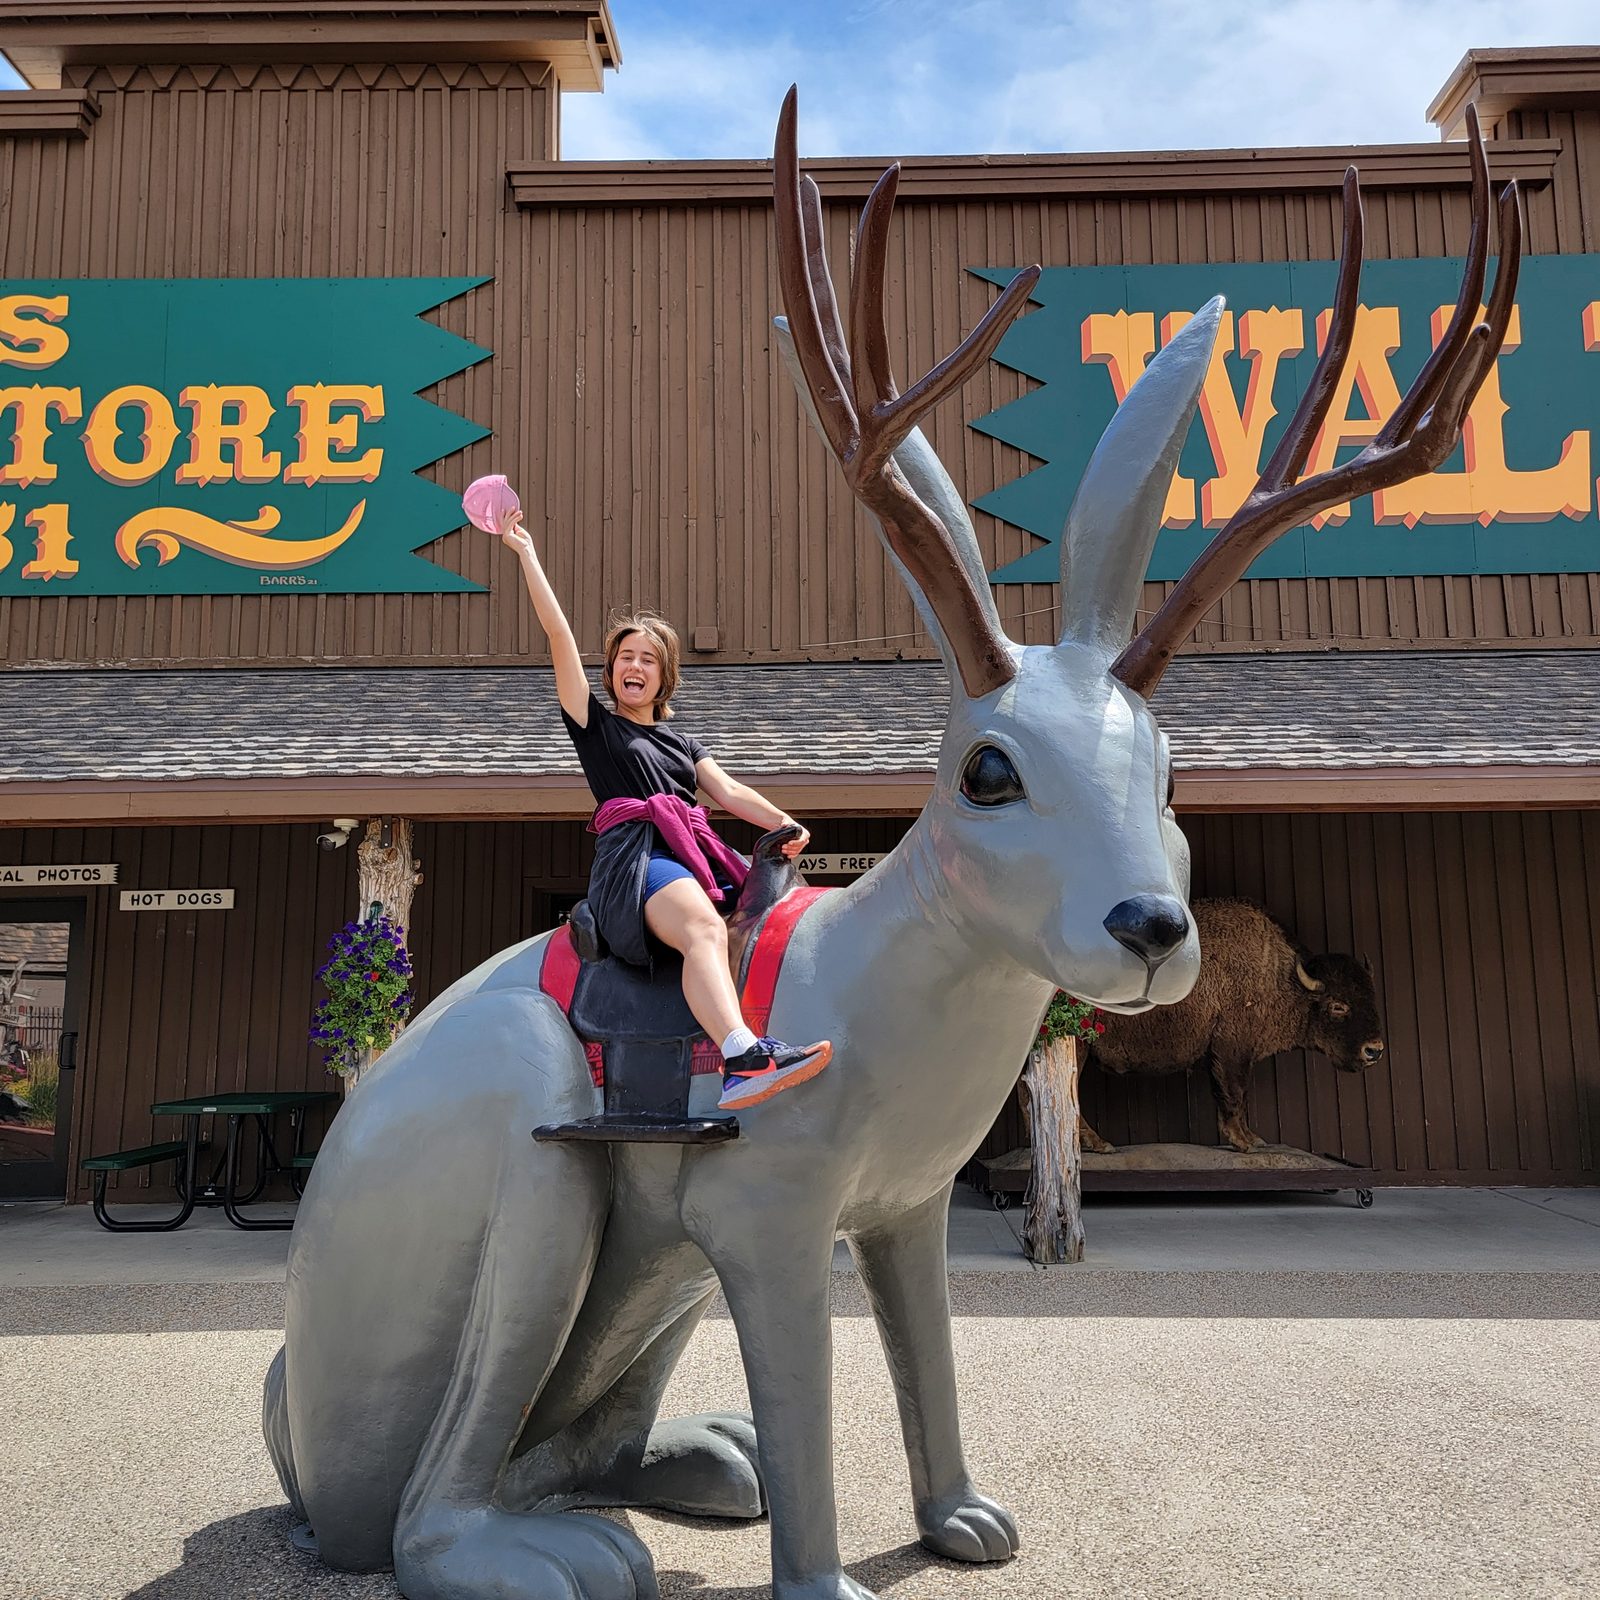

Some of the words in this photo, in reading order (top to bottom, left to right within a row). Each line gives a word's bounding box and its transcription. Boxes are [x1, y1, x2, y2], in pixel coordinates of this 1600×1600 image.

[0, 294, 70, 371] S
[1081, 301, 1600, 532] WAL
[798, 857, 828, 871] AYS
[840, 857, 876, 870] FREE
[0, 869, 24, 882] AL
[37, 868, 101, 882] PHOTOS
[131, 893, 165, 906] HOT
[177, 892, 223, 905] DOGS
